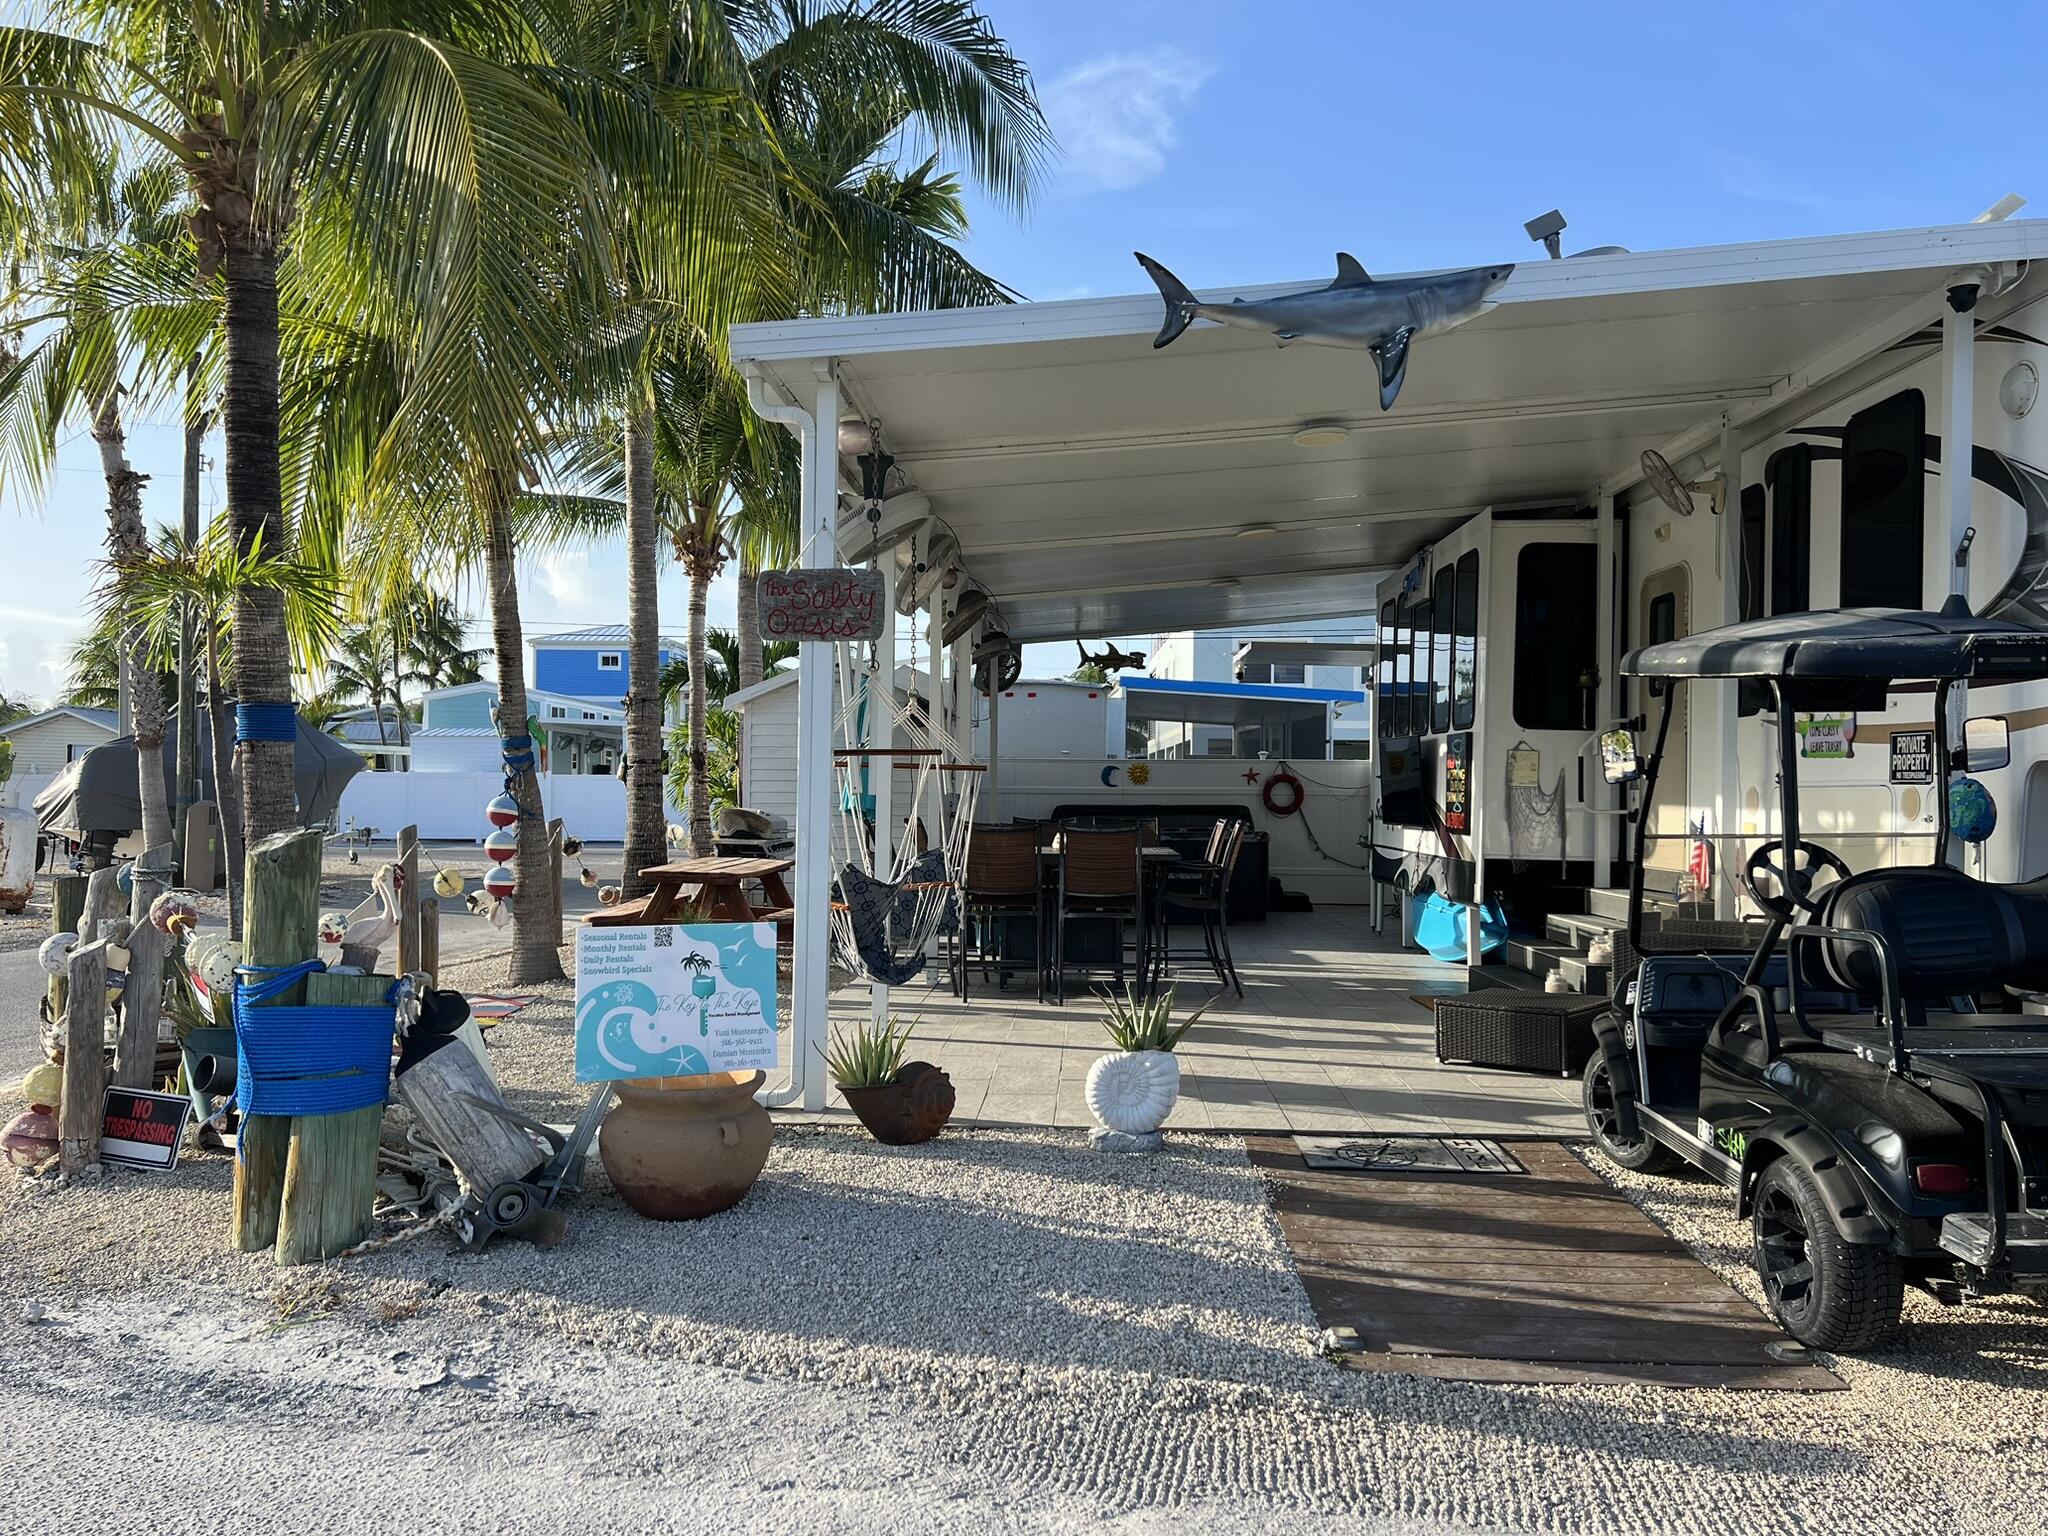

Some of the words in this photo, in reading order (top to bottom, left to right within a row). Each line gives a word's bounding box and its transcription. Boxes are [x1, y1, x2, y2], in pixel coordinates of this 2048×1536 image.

[791, 579, 876, 621] Salty
[768, 608, 870, 639] Oasis
[1896, 735, 1926, 753] PRIVATE
[1892, 753, 1931, 771] PROPERTY
[583, 933, 617, 942] Seasonal
[619, 932, 647, 941] Rentals
[583, 944, 617, 953] Monthly
[618, 943, 647, 952] Rentals
[583, 956, 605, 965] Daily
[605, 954, 634, 963] Rentals
[583, 966, 620, 975] Snowbird
[622, 965, 652, 975] Specials
[656, 994, 671, 1012] The
[674, 993, 697, 1016] Key
[713, 991, 730, 1010] The
[713, 1049, 738, 1058] Damian
[131, 1099, 153, 1119] NO
[105, 1115, 177, 1145] TRESPASSING
